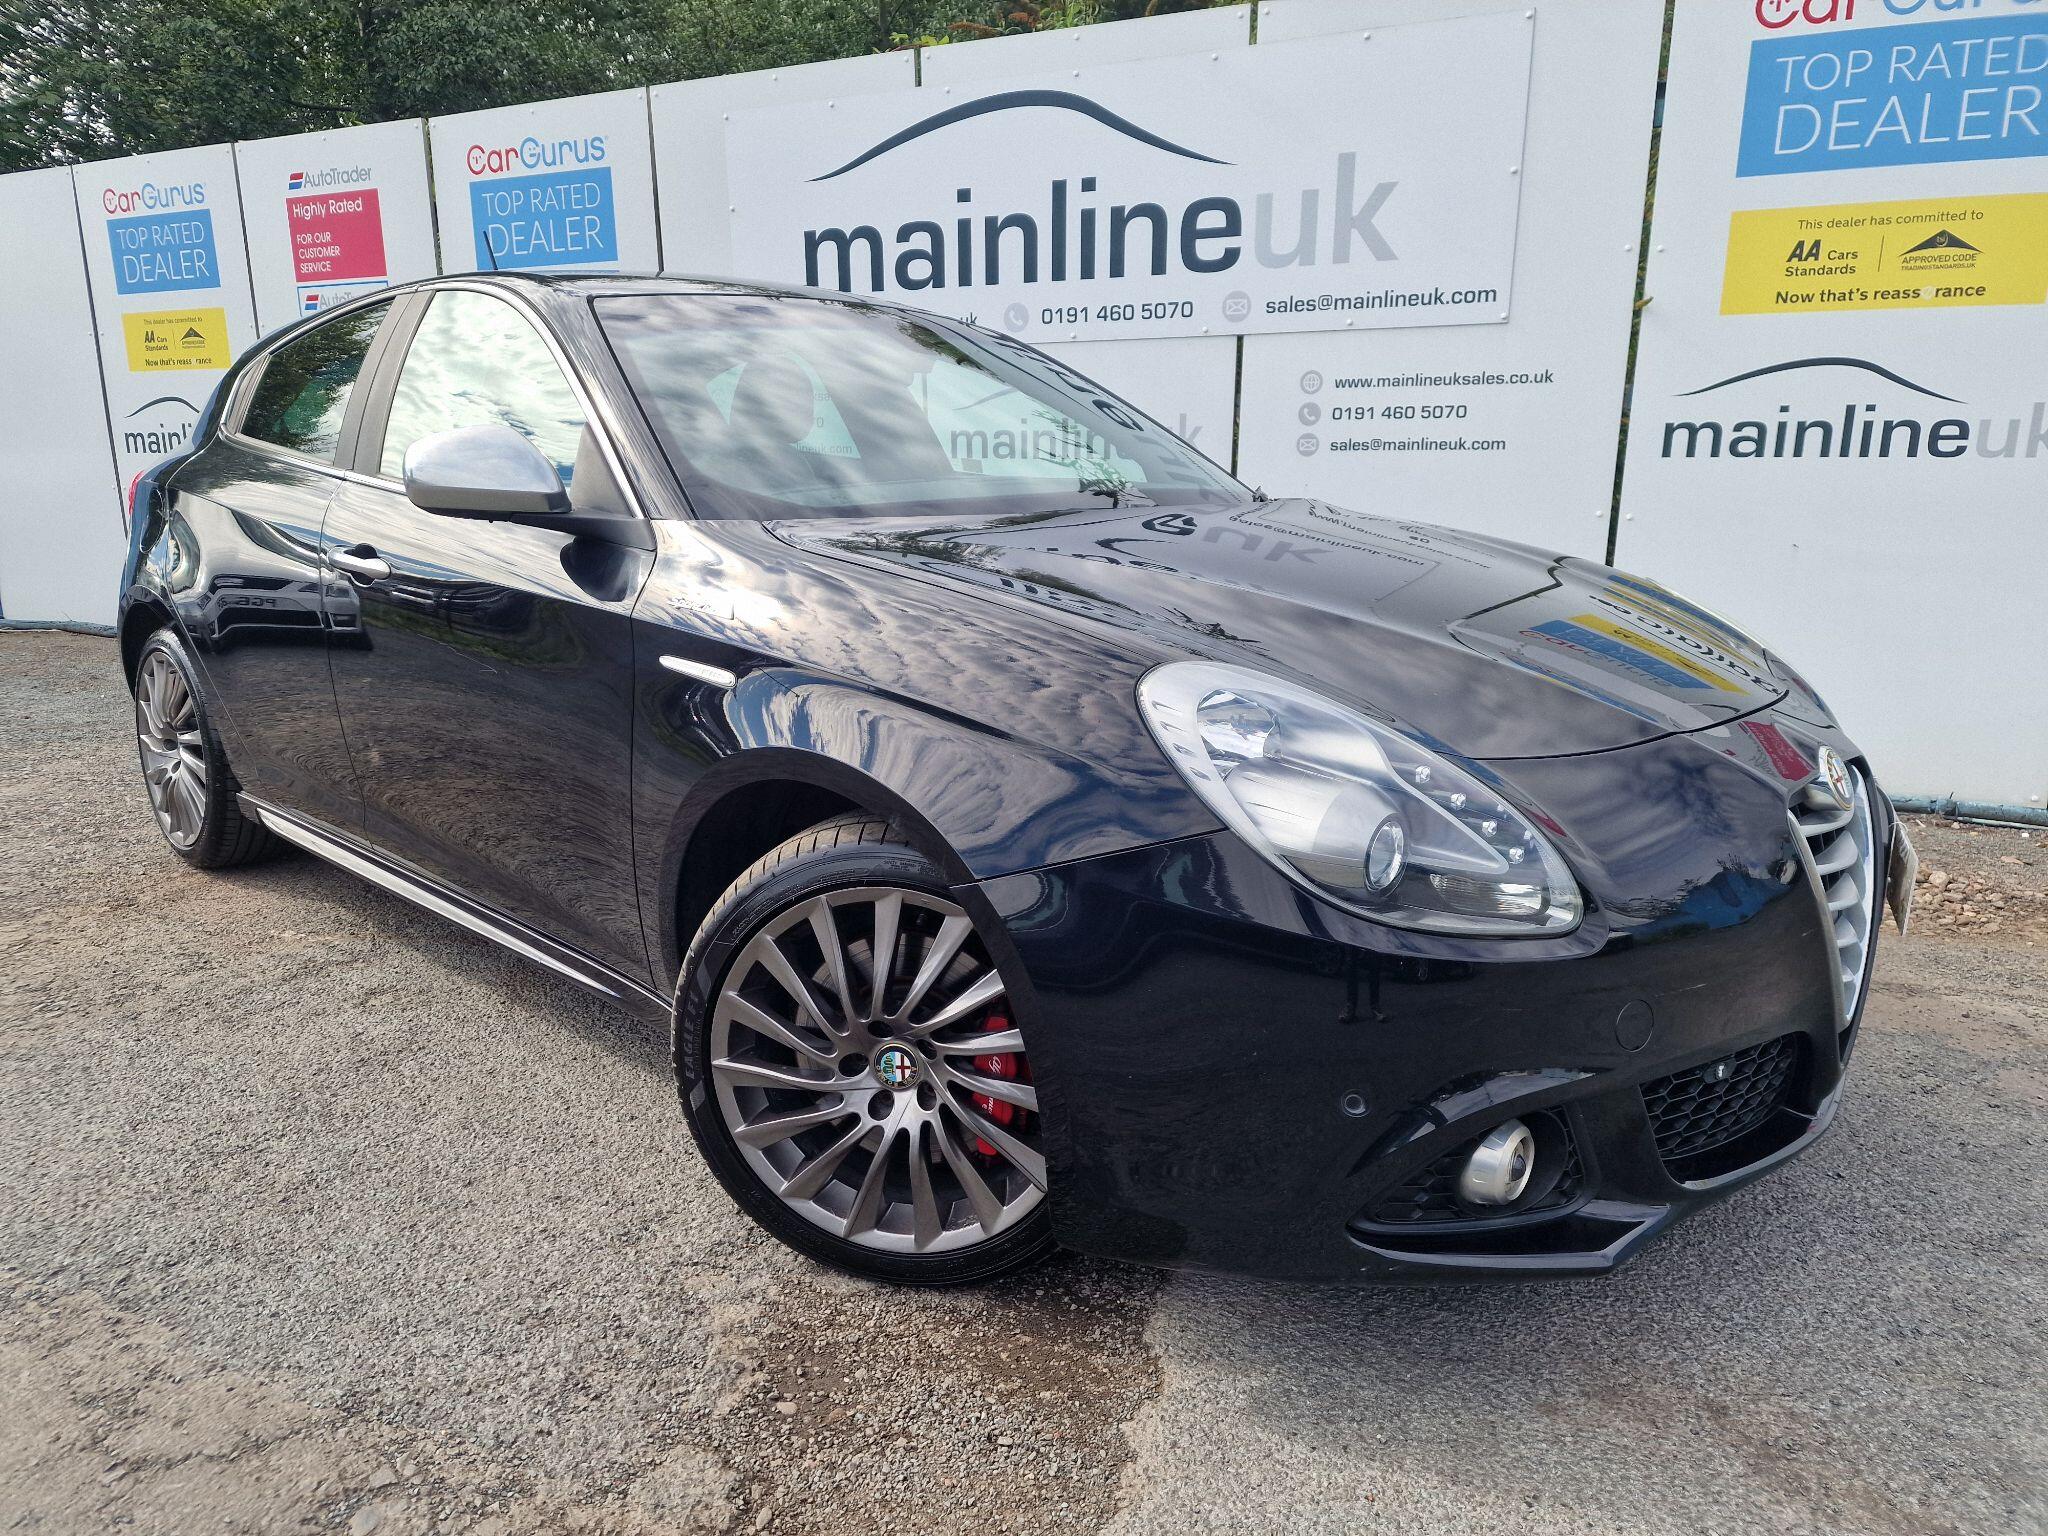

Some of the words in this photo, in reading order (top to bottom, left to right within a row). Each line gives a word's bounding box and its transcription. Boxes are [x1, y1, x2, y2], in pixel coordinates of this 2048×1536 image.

[1776, 49, 1873, 95] TOP
[1888, 34, 2048, 84] RATED
[1773, 85, 2042, 155] DEALER
[467, 136, 606, 176] CarGurus
[304, 165, 372, 188] AutoTrader
[103, 183, 205, 214] CarGurus
[293, 202, 326, 220] Highly
[329, 197, 363, 214] Rated
[482, 190, 524, 217] TOP
[531, 182, 600, 212] RATED
[804, 151, 1400, 293] mainlineuk
[1797, 219, 1823, 230] This
[1827, 217, 1867, 228] dealer
[1870, 215, 1892, 226] has
[1896, 210, 1967, 225] committed
[1971, 209, 1984, 220] to
[116, 227, 148, 249] TOP
[152, 222, 204, 247] RATED
[297, 233, 312, 244] FOR
[314, 231, 331, 243] OUR
[487, 215, 604, 257] DEALER
[299, 245, 341, 259] CUSTOMER
[1786, 239, 1822, 263] AA
[1827, 250, 1859, 261] Cars
[1901, 254, 1951, 264] APPROVED
[1952, 253, 1978, 262] CODE
[123, 249, 210, 283] DEALER
[300, 261, 332, 273] SERVICE
[1784, 263, 1857, 277] Standards
[1265, 286, 1498, 315] sales@mainlineuk.com
[1775, 290, 1816, 304] Now
[1819, 287, 1869, 302] that's
[1873, 285, 1987, 301] reassrance
[1041, 306, 1090, 325] 0191
[1096, 304, 1135, 322] 460
[1141, 301, 1194, 320] 5070
[144, 330, 155, 343] AA
[145, 344, 169, 352] Standards
[145, 358, 159, 366] Now
[176, 357, 212, 366] reassrance
[1334, 369, 1554, 389] www.mainlineuksales.co.uk
[1332, 407, 1375, 421] 0191
[1381, 406, 1416, 420] 460
[1420, 405, 1468, 420] 5070
[1330, 437, 1507, 452] sales@mainlineuk.com
